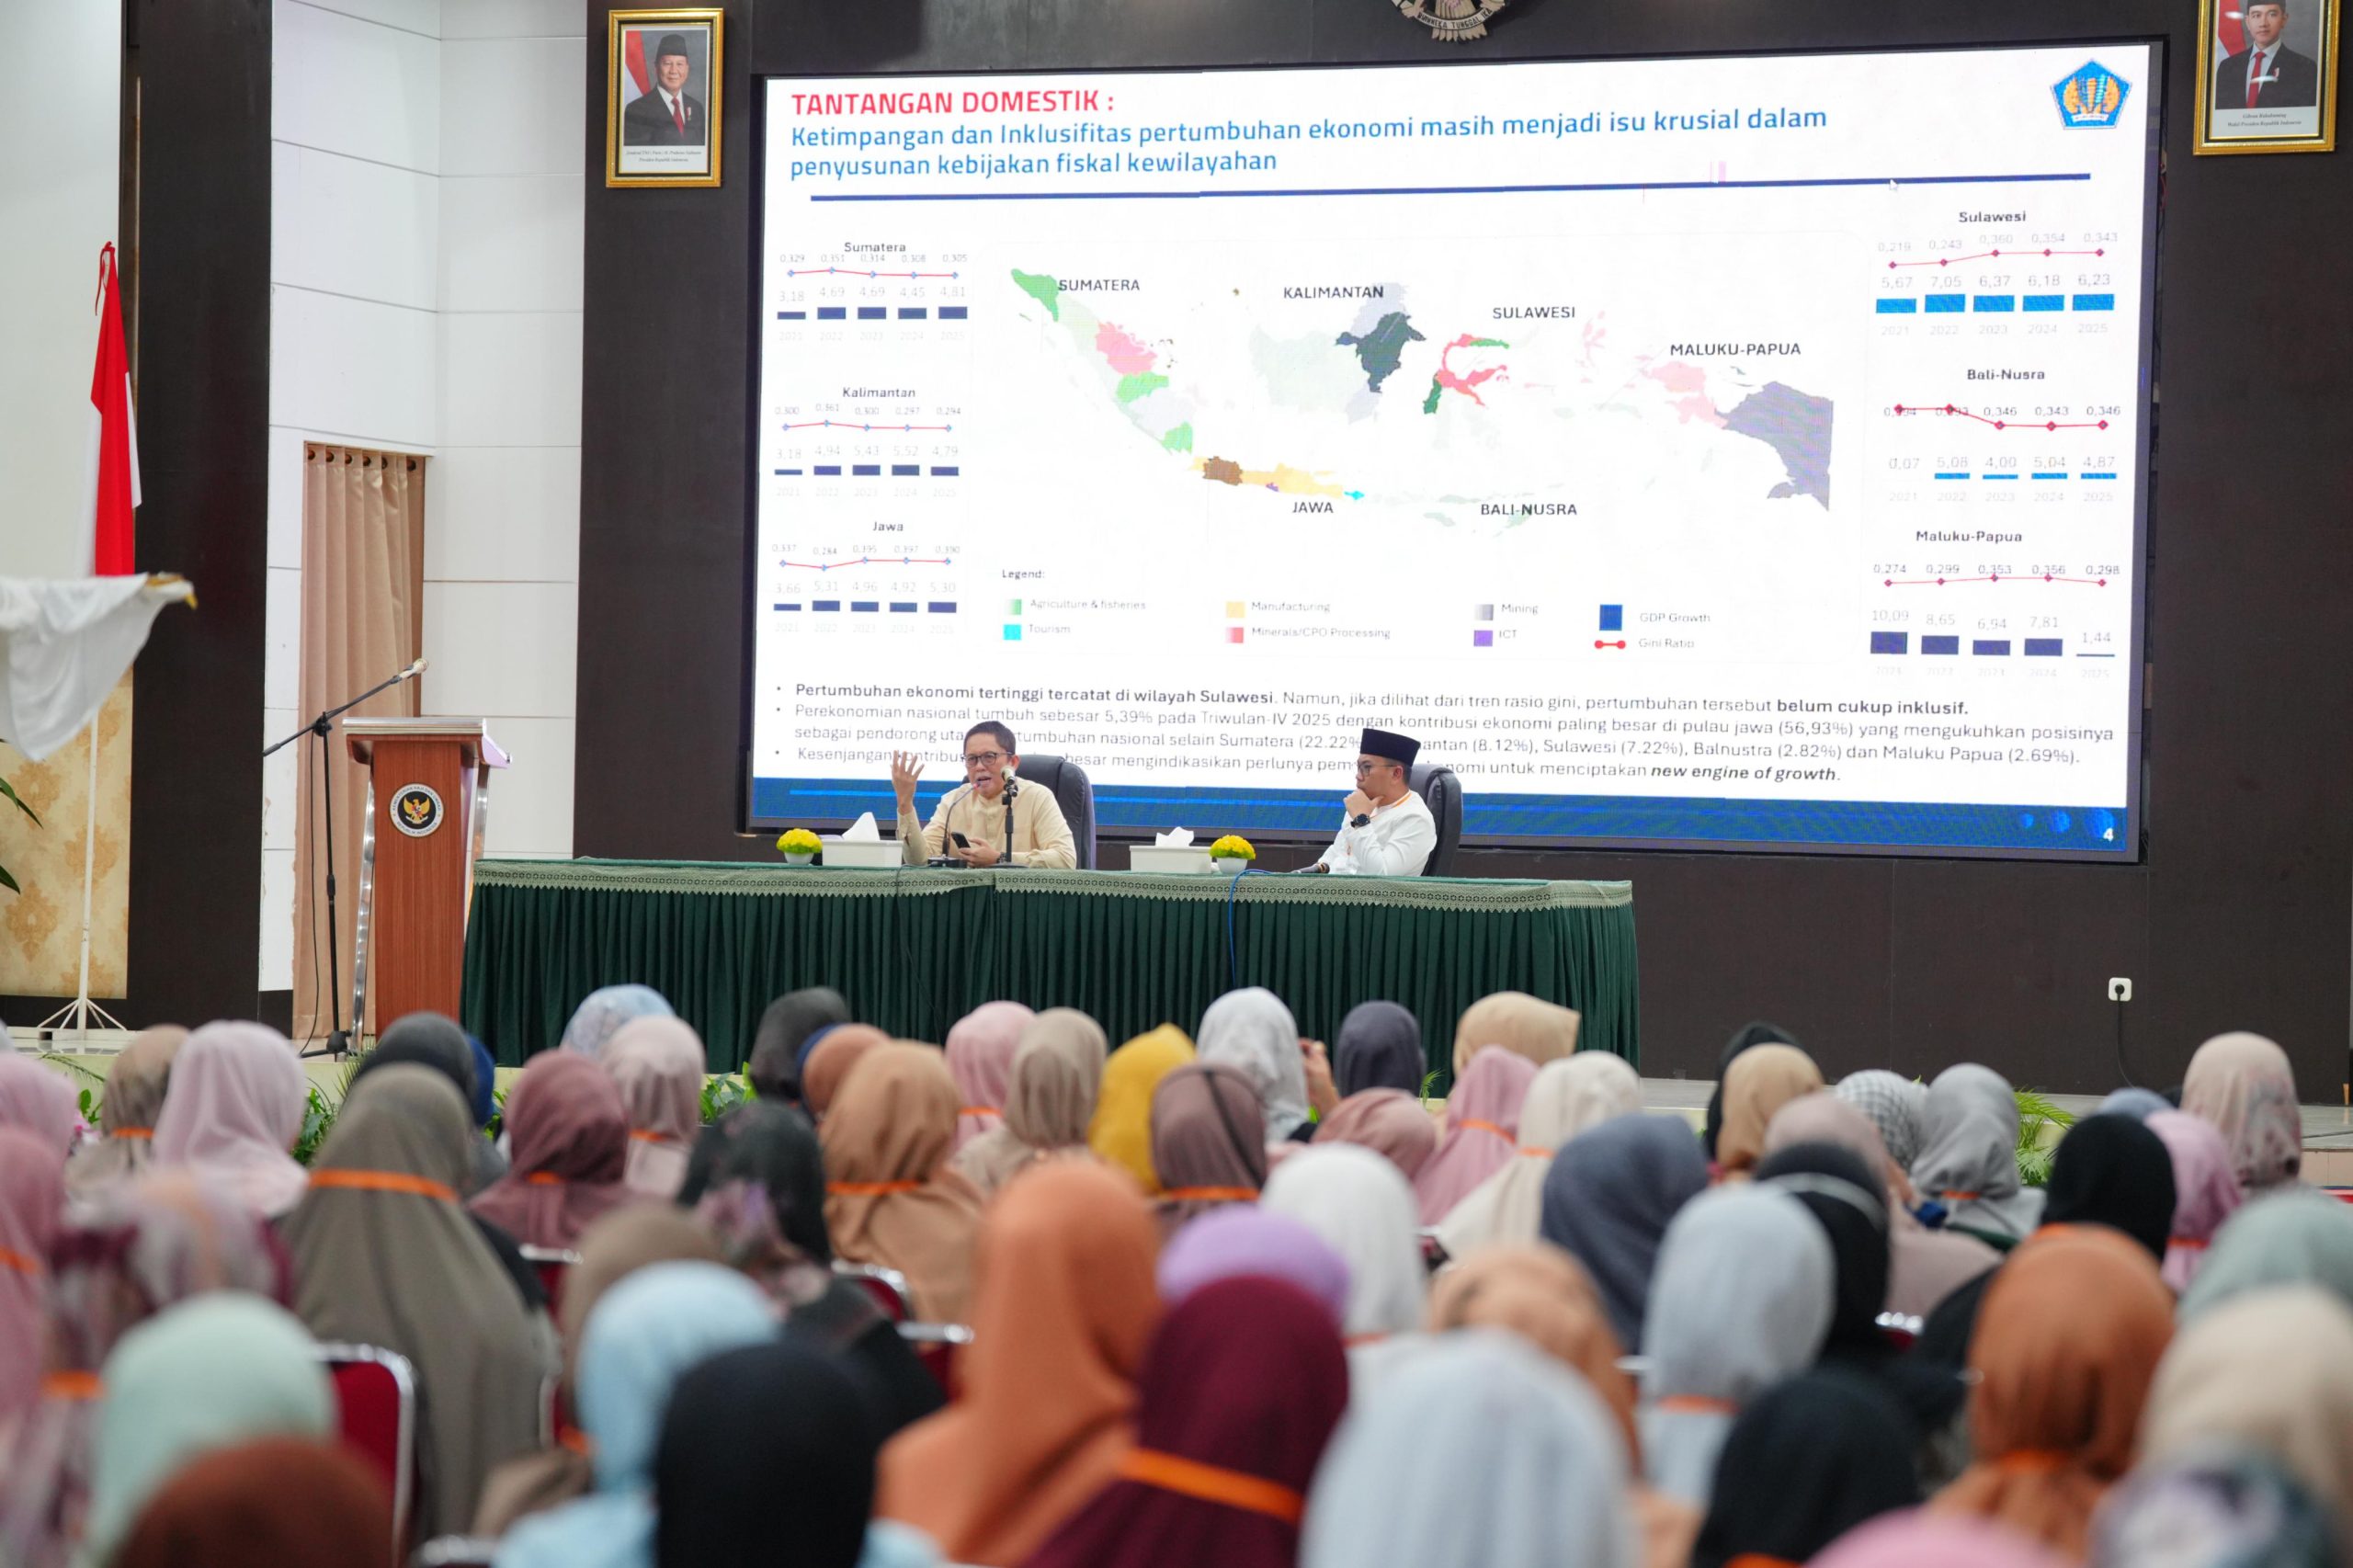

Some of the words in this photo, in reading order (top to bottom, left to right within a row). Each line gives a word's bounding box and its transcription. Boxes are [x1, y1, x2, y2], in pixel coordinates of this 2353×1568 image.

[791, 92, 952, 115] TANTANGAN
[963, 90, 1098, 113] DOMESTIK
[792, 127, 943, 151] Ketimpangan
[951, 125, 993, 144] dan
[1001, 122, 1131, 143] Inklusifitas
[1140, 119, 1301, 147] pertumbuhan
[1309, 117, 1413, 139] ekonomi
[1421, 115, 1495, 136] masih
[1503, 112, 1600, 139] menjadi
[1610, 112, 1645, 132] isu
[1654, 108, 1738, 131] krusial
[1748, 108, 1826, 129] dalam
[791, 160, 930, 181] penyusunan
[938, 153, 1049, 179] kebijakan
[1057, 153, 1120, 173] fiskal
[1128, 150, 1277, 176] kewilayahan
[1959, 210, 2026, 222] Sulawesi
[844, 242, 905, 252] Sumatera
[1056, 279, 1140, 294] SUMATERA
[1882, 277, 1913, 290] 5,67
[1930, 276, 1961, 290] 7,05
[1979, 275, 2011, 289] 6,37
[2028, 274, 2060, 288] 6,18
[2077, 273, 2110, 287] 6,23
[1284, 285, 1384, 299] KALIMANTAN
[1493, 307, 1574, 319] SULAWESI
[1671, 343, 1801, 356] MALUKU-PAPUA
[1967, 369, 2044, 380] Bali-Nusra
[843, 387, 915, 397] Kalimantan
[1984, 407, 2017, 417] 0,346
[2035, 406, 2069, 416] 0,343
[2086, 406, 2120, 416] 0,346
[1985, 456, 2017, 470] 4,00
[1292, 502, 1334, 513] JAWA
[1481, 504, 1576, 517] BALI-NUSRA
[873, 521, 904, 531] Jawa
[1916, 530, 2022, 544] Maluku-Papua
[1002, 569, 1044, 580] Legend:
[1030, 599, 1088, 610] Agriculture
[1101, 599, 1146, 610] fisheries
[1251, 601, 1330, 614] Manufacturing
[1501, 604, 1539, 616] Mining
[1640, 613, 1665, 622] GDP
[1669, 613, 1711, 623] Growth
[1028, 623, 1071, 633] Tourism
[1252, 627, 1327, 637] Minerals/CPO
[1331, 628, 1390, 640] Processing
[1498, 630, 1517, 639] ICT
[1638, 638, 1663, 647] Gini
[1665, 638, 1694, 648] Ratio
[796, 684, 901, 697] Pertumbuhan
[906, 686, 973, 698] ekonomi
[979, 687, 1042, 702] tertinggi
[1048, 689, 1110, 700] tercatat
[1116, 689, 1130, 701] di
[1134, 690, 1195, 705] wilayah
[1200, 690, 1277, 703] Sulawesi.
[1283, 692, 1345, 706] Namun,
[1349, 693, 1376, 708] jika
[1381, 693, 1429, 706] dilihat
[1435, 694, 1463, 707] dari
[1469, 697, 1500, 707] tren
[1505, 696, 1543, 708] rasio
[1548, 696, 1580, 711] gini,
[1586, 697, 1697, 711] pertumbuhan
[1703, 699, 1771, 711] tersebut
[1778, 699, 1832, 712] belum
[1838, 700, 1893, 716] cukup
[1898, 701, 1968, 714] inklusif.
[796, 704, 902, 718] Perekonomian
[907, 707, 971, 719] nasional
[975, 708, 1034, 721] tumbuh
[1040, 710, 1099, 722] sebesar
[1106, 710, 1153, 724] 5,39%
[1158, 711, 1196, 726] pada
[1201, 710, 1287, 725] Triwulan-IV
[1292, 713, 1330, 726] 2025
[1336, 715, 1393, 729] dengan
[1400, 715, 1477, 728] kontribusi
[1483, 717, 1552, 729] ekonomi
[1558, 718, 1607, 733] paling
[1612, 718, 1656, 732] besar
[1663, 720, 1677, 732] di
[1683, 721, 1728, 734] pulau
[1734, 723, 1772, 736] jawa
[1779, 721, 1853, 738] (56,93%)
[1859, 725, 1898, 739] yang
[1904, 724, 2025, 740] mengukuhkan
[2032, 729, 2113, 743] posisinya
[795, 726, 851, 741] sebagai
[857, 728, 937, 744] pendorong
[1100, 733, 1165, 745] nasional
[1169, 733, 1214, 746] selain
[1220, 733, 1293, 747] Sumatera
[1473, 739, 1538, 755] (8.12%),
[1544, 739, 1616, 753] Sulawesi
[1621, 741, 1688, 757] (7.22%),
[1694, 742, 1772, 756] Balnustra
[1778, 744, 1841, 760] (2.82%)
[1847, 745, 1877, 758] dan
[1883, 745, 1944, 759] Maluku
[1950, 746, 2003, 763] Papua
[2008, 748, 2079, 766] (2.69%).
[798, 747, 891, 764] Kesenjangan
[1112, 756, 1241, 770] mengindikasikan
[1246, 757, 1313, 772] perlunya
[1490, 762, 1534, 774] untuk
[1540, 764, 1646, 778] menciptakan
[1651, 767, 1688, 777] new
[1692, 766, 1749, 780] engine
[1755, 767, 1772, 778] of
[1774, 767, 1840, 782] growth.
[2103, 828, 2113, 841] 4
